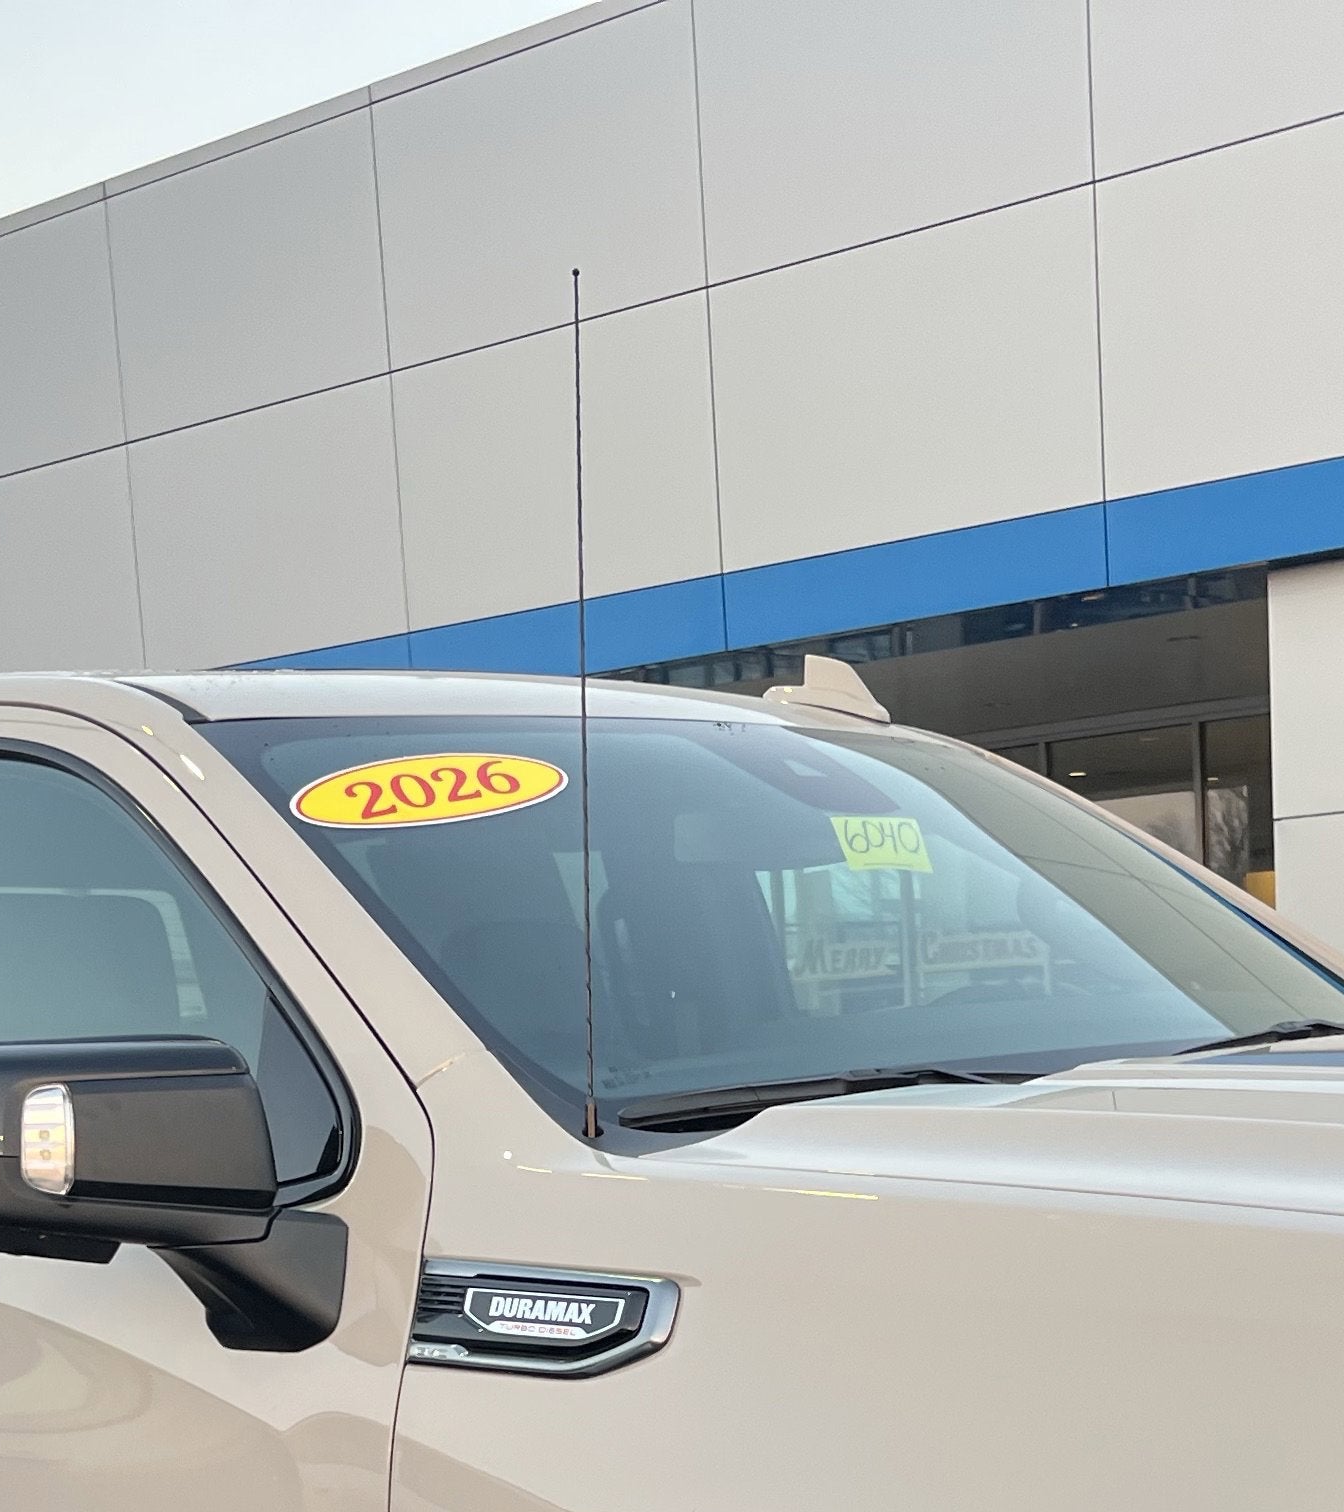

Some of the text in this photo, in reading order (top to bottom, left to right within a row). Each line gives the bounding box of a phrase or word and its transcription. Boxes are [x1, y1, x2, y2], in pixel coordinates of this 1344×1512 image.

[344, 760, 521, 820] 2026
[843, 819, 920, 854] 6040
[488, 1295, 596, 1325] DURAMAX
[499, 1322, 536, 1333] TURBO
